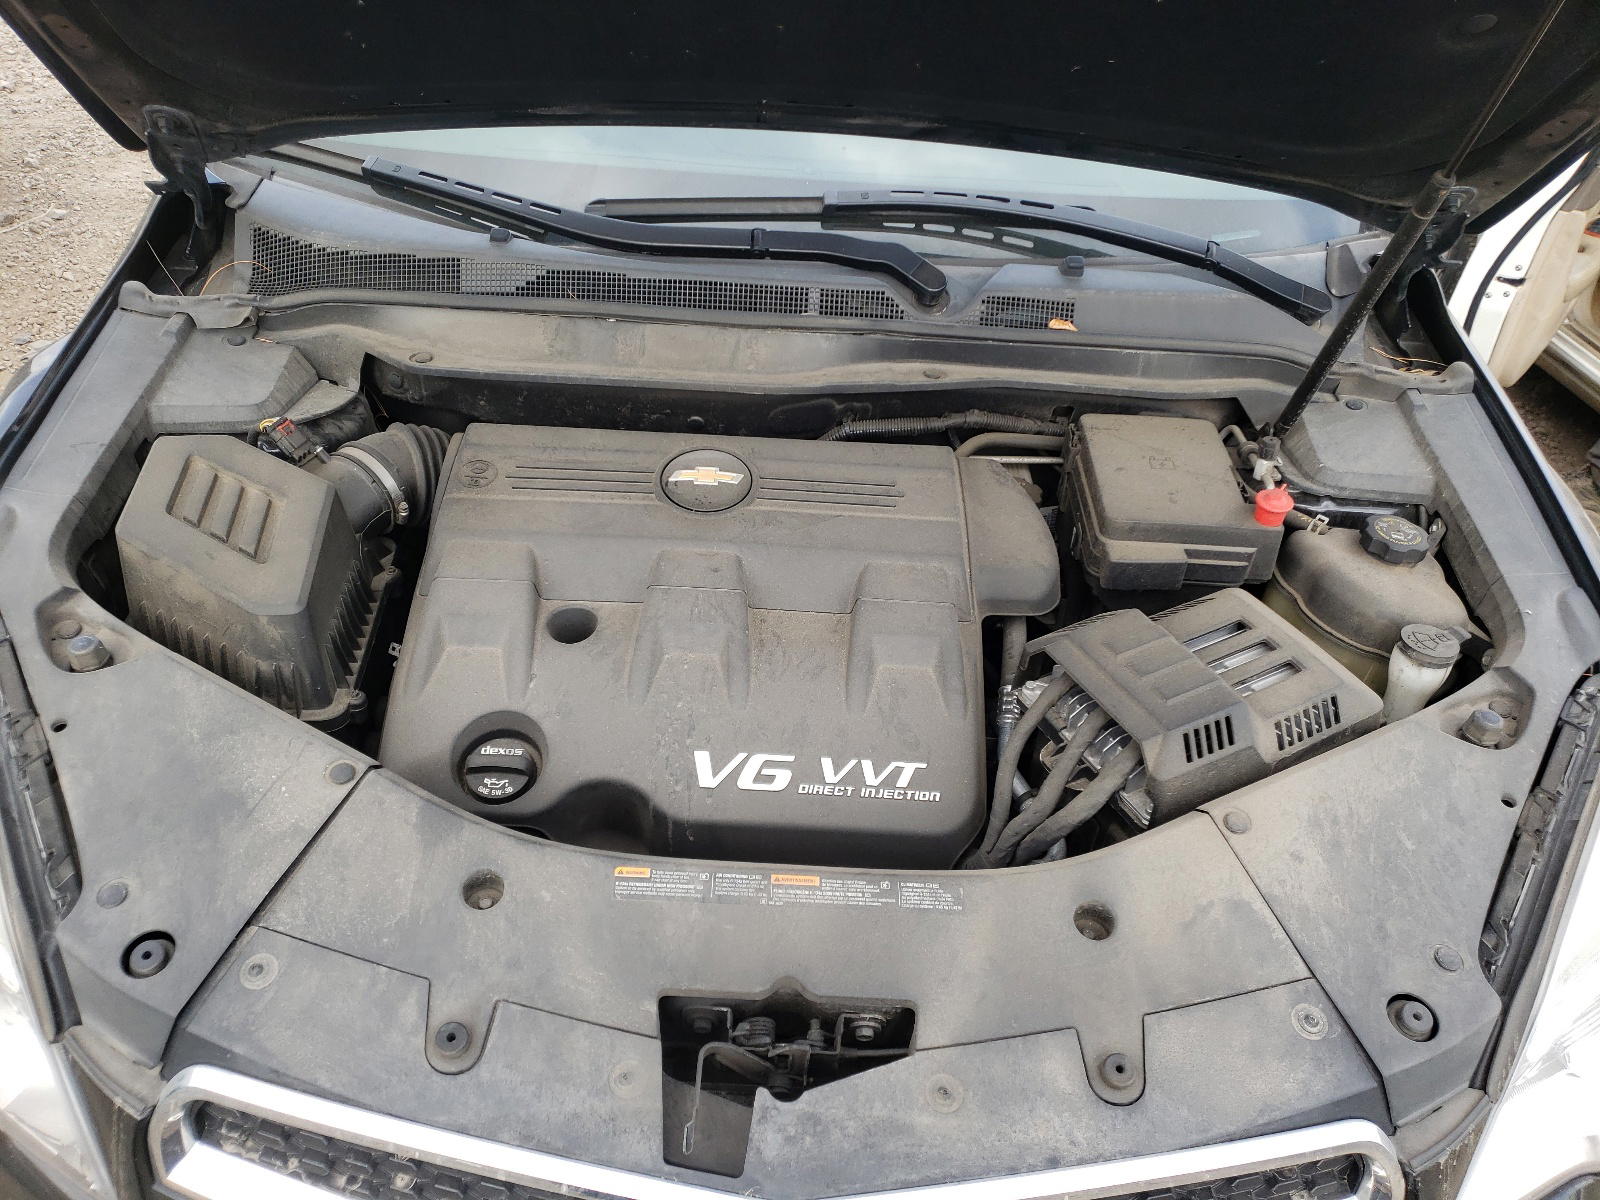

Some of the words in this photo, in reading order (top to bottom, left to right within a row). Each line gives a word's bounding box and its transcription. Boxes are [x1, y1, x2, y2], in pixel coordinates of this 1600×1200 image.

[480, 745, 525, 756] dexos
[693, 750, 796, 792] V6
[820, 757, 928, 788] VVT
[478, 785, 490, 795] SAE
[798, 784, 855, 797] DIRECT
[860, 787, 941, 802] INJECTION
